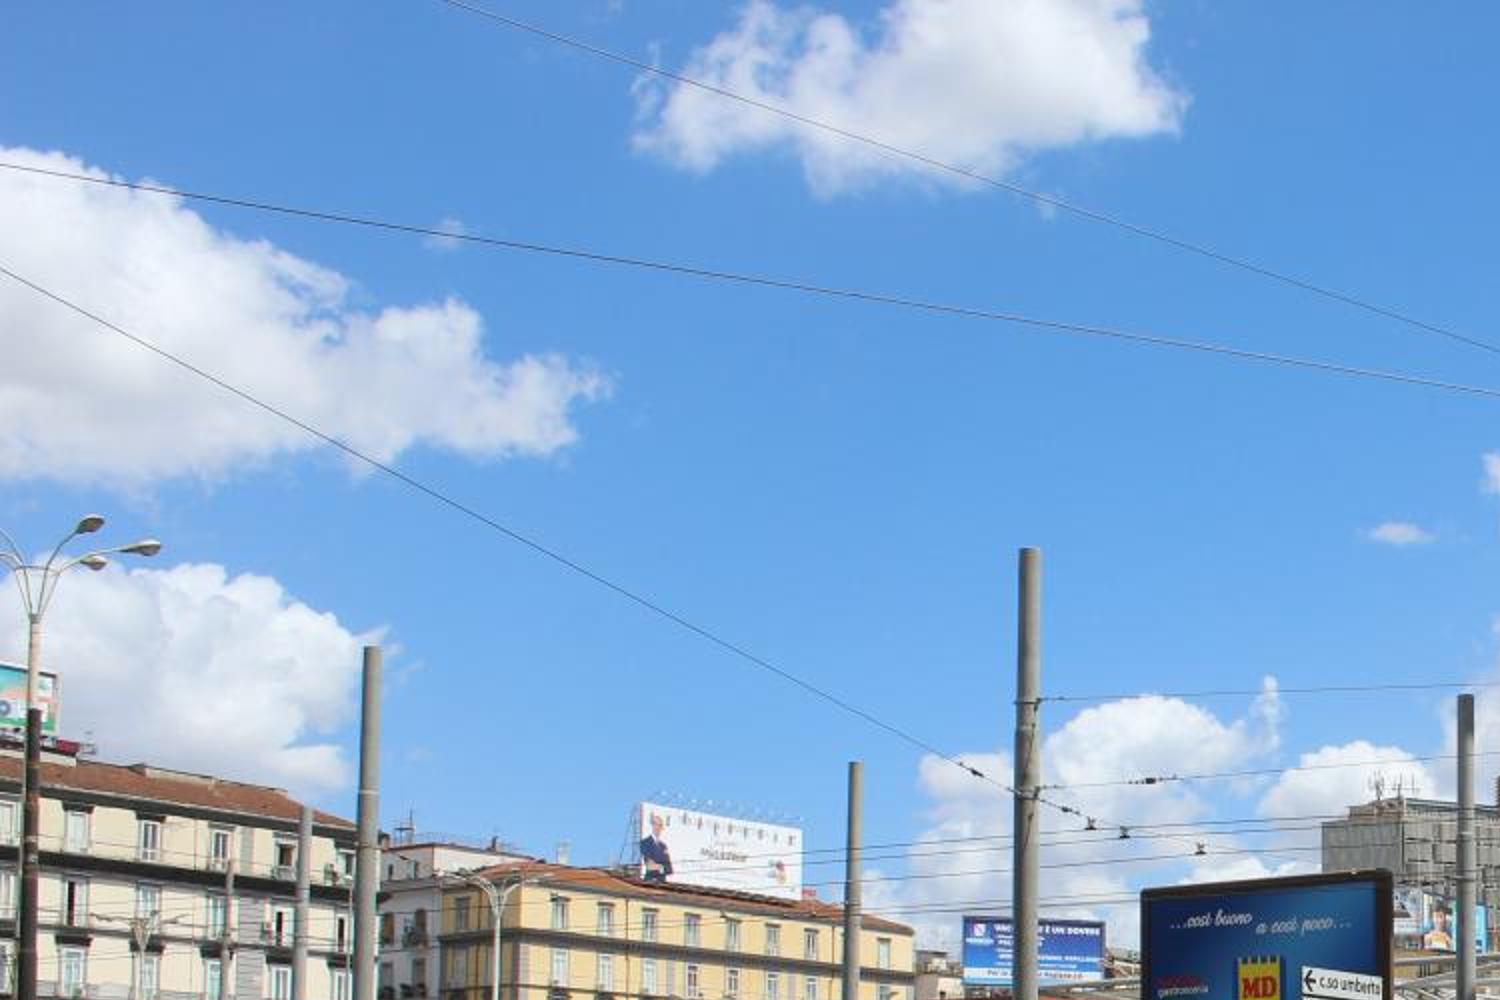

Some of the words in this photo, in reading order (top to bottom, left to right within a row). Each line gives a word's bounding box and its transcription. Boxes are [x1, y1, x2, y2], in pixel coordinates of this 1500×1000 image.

[1214, 908, 1252, 928] buono
[1241, 975, 1278, 1000] MD
[1340, 977, 1380, 996] umberto
